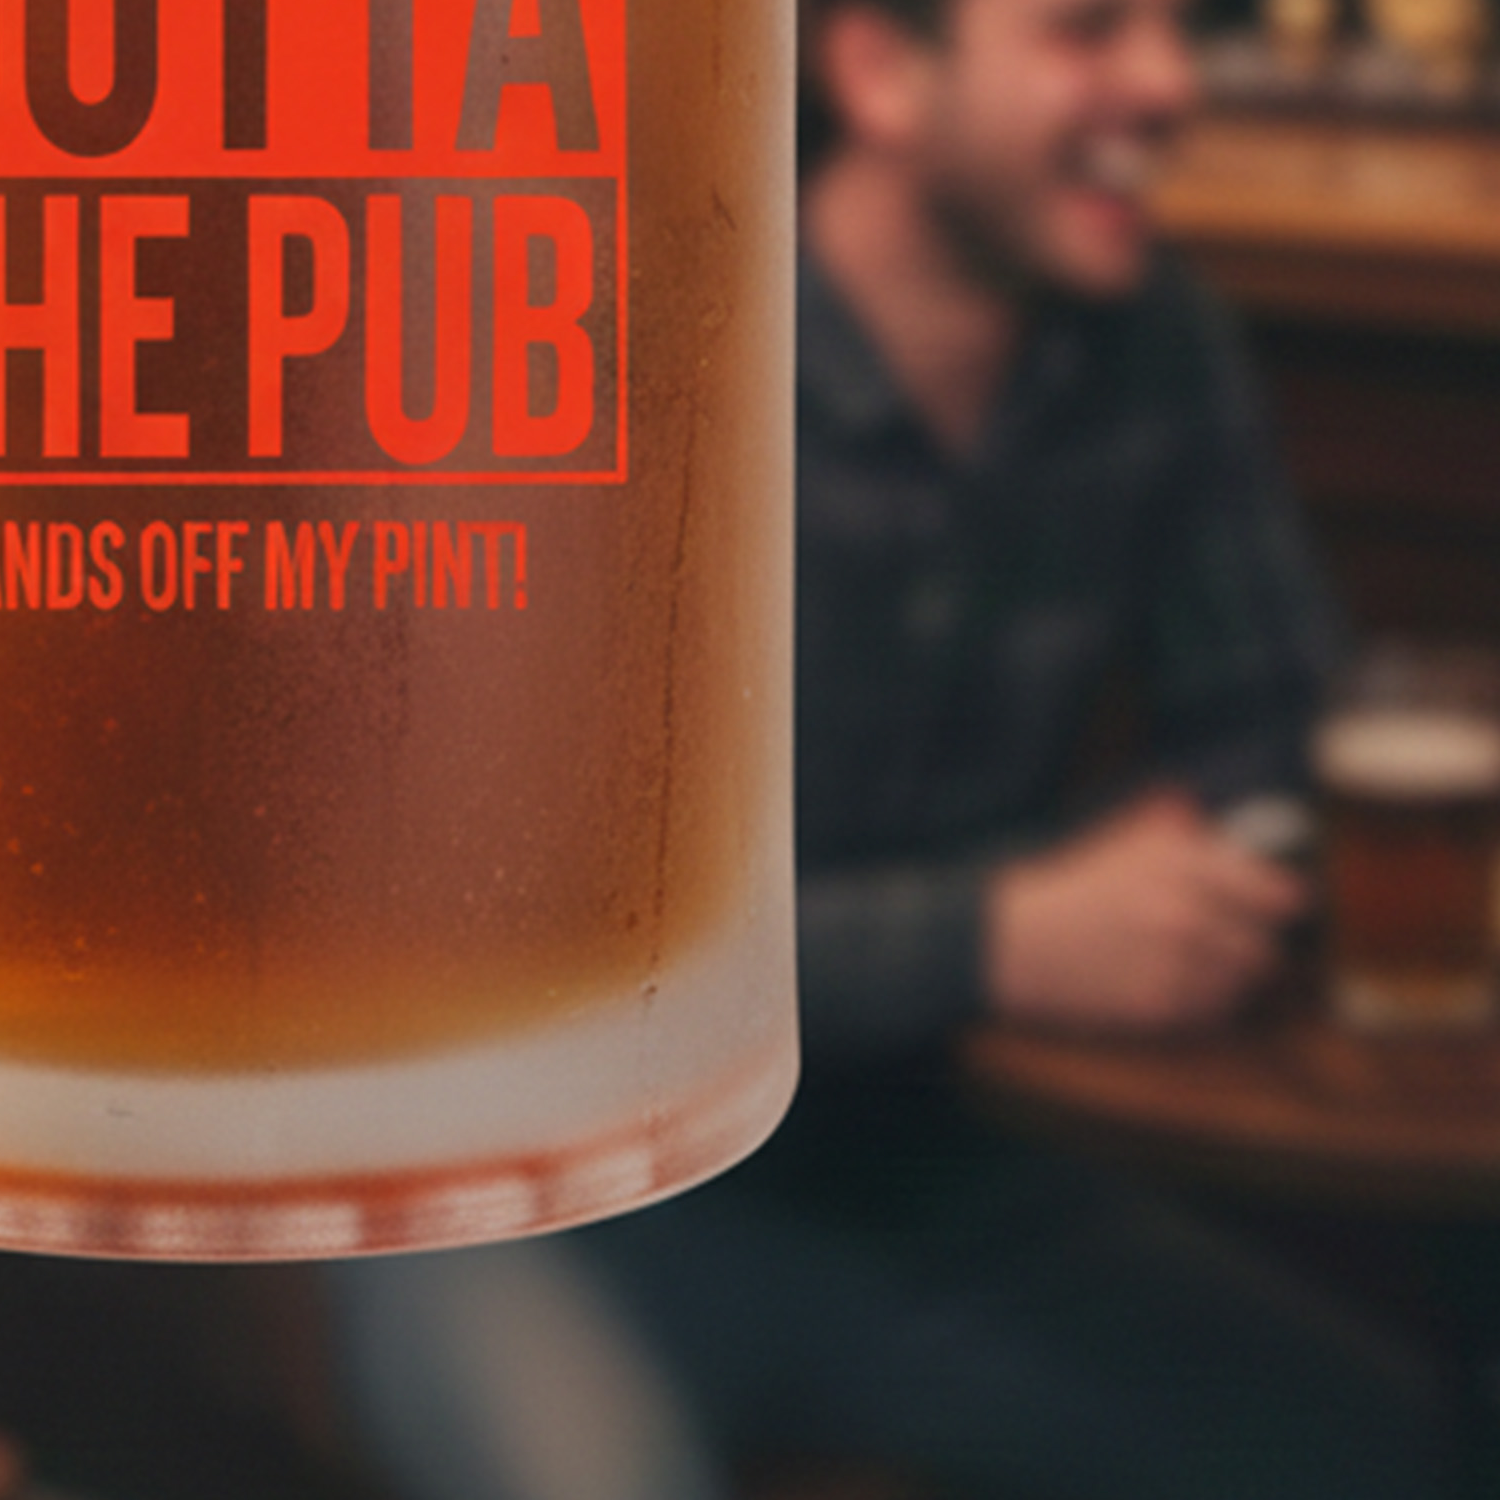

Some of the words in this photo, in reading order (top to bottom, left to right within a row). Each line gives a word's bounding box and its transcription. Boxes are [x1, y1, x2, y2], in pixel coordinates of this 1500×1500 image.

[248, 194, 595, 465] PUB
[140, 521, 250, 611] OFF
[264, 521, 360, 611] MY
[373, 521, 529, 611] PINT!
